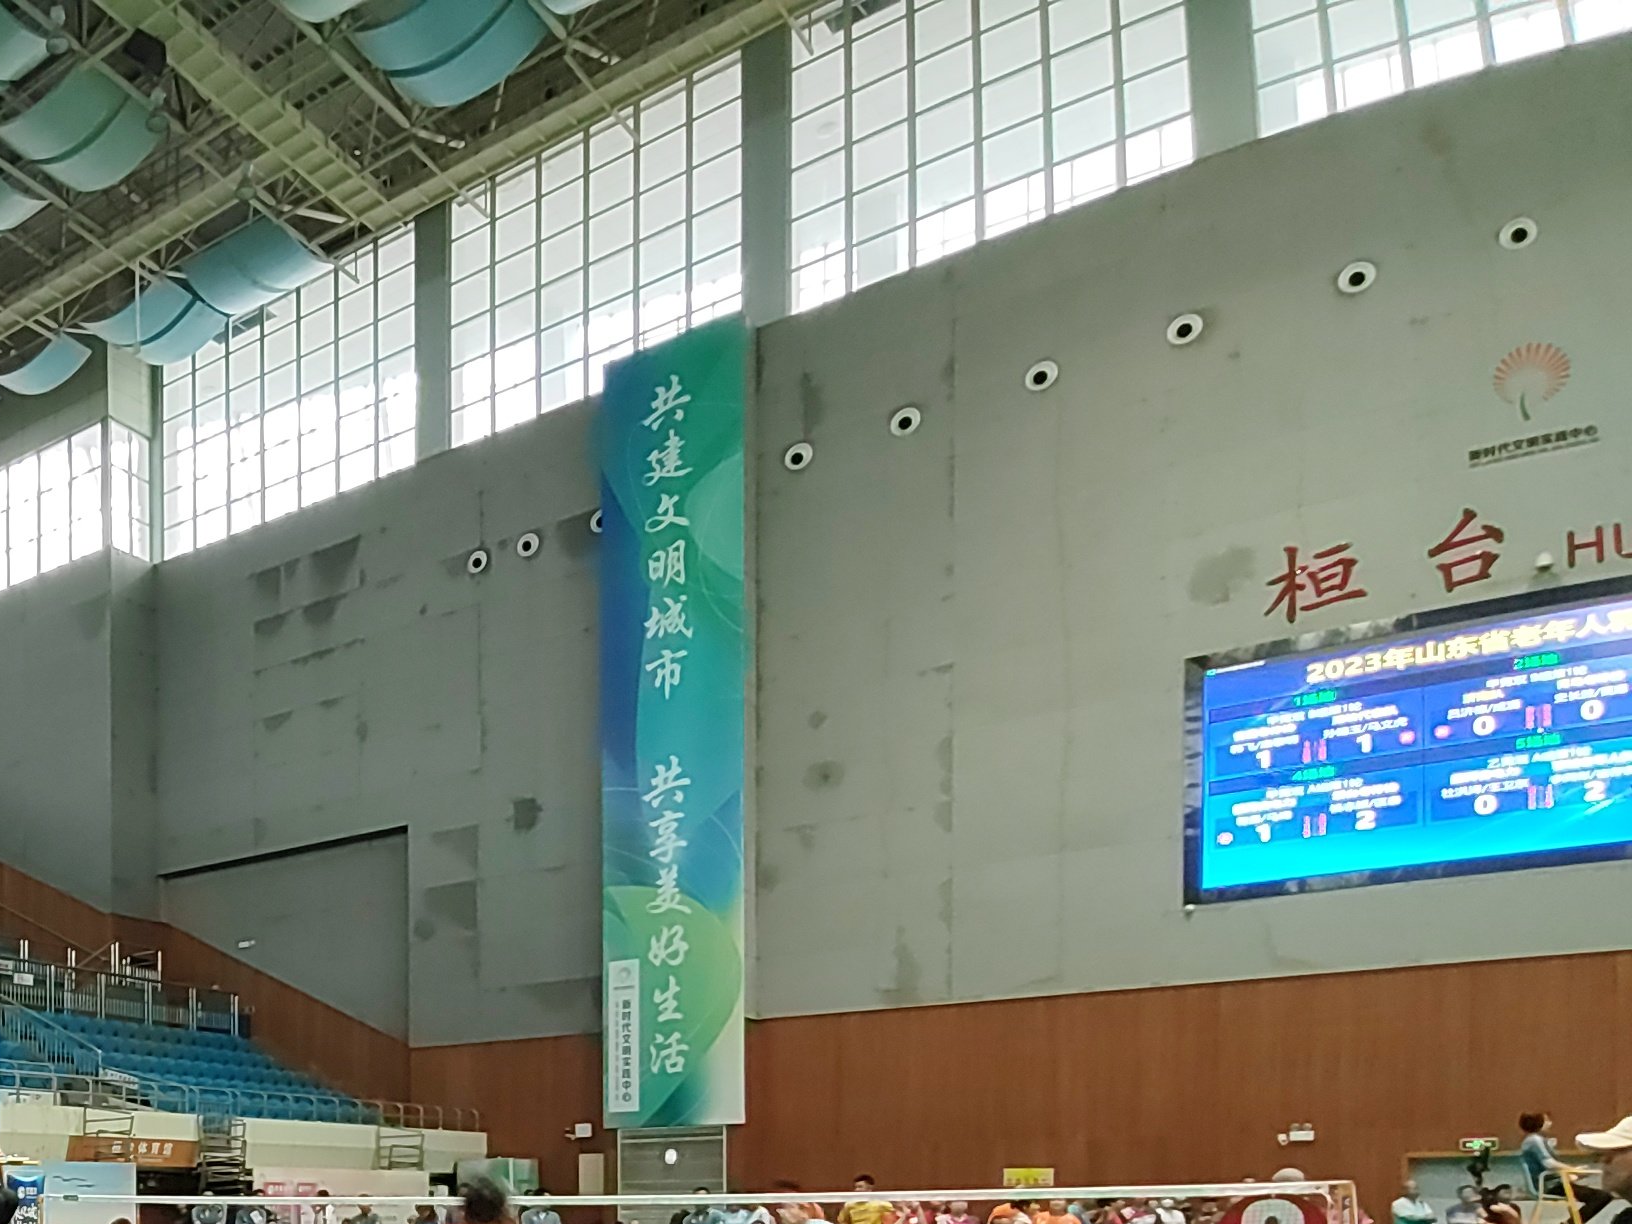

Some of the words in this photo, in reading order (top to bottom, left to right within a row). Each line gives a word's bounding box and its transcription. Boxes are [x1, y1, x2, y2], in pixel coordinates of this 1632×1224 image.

[641, 373, 695, 702] 共建文明城市
[1264, 507, 1505, 623] 桓台
[643, 754, 693, 1078] 共享美好生活
